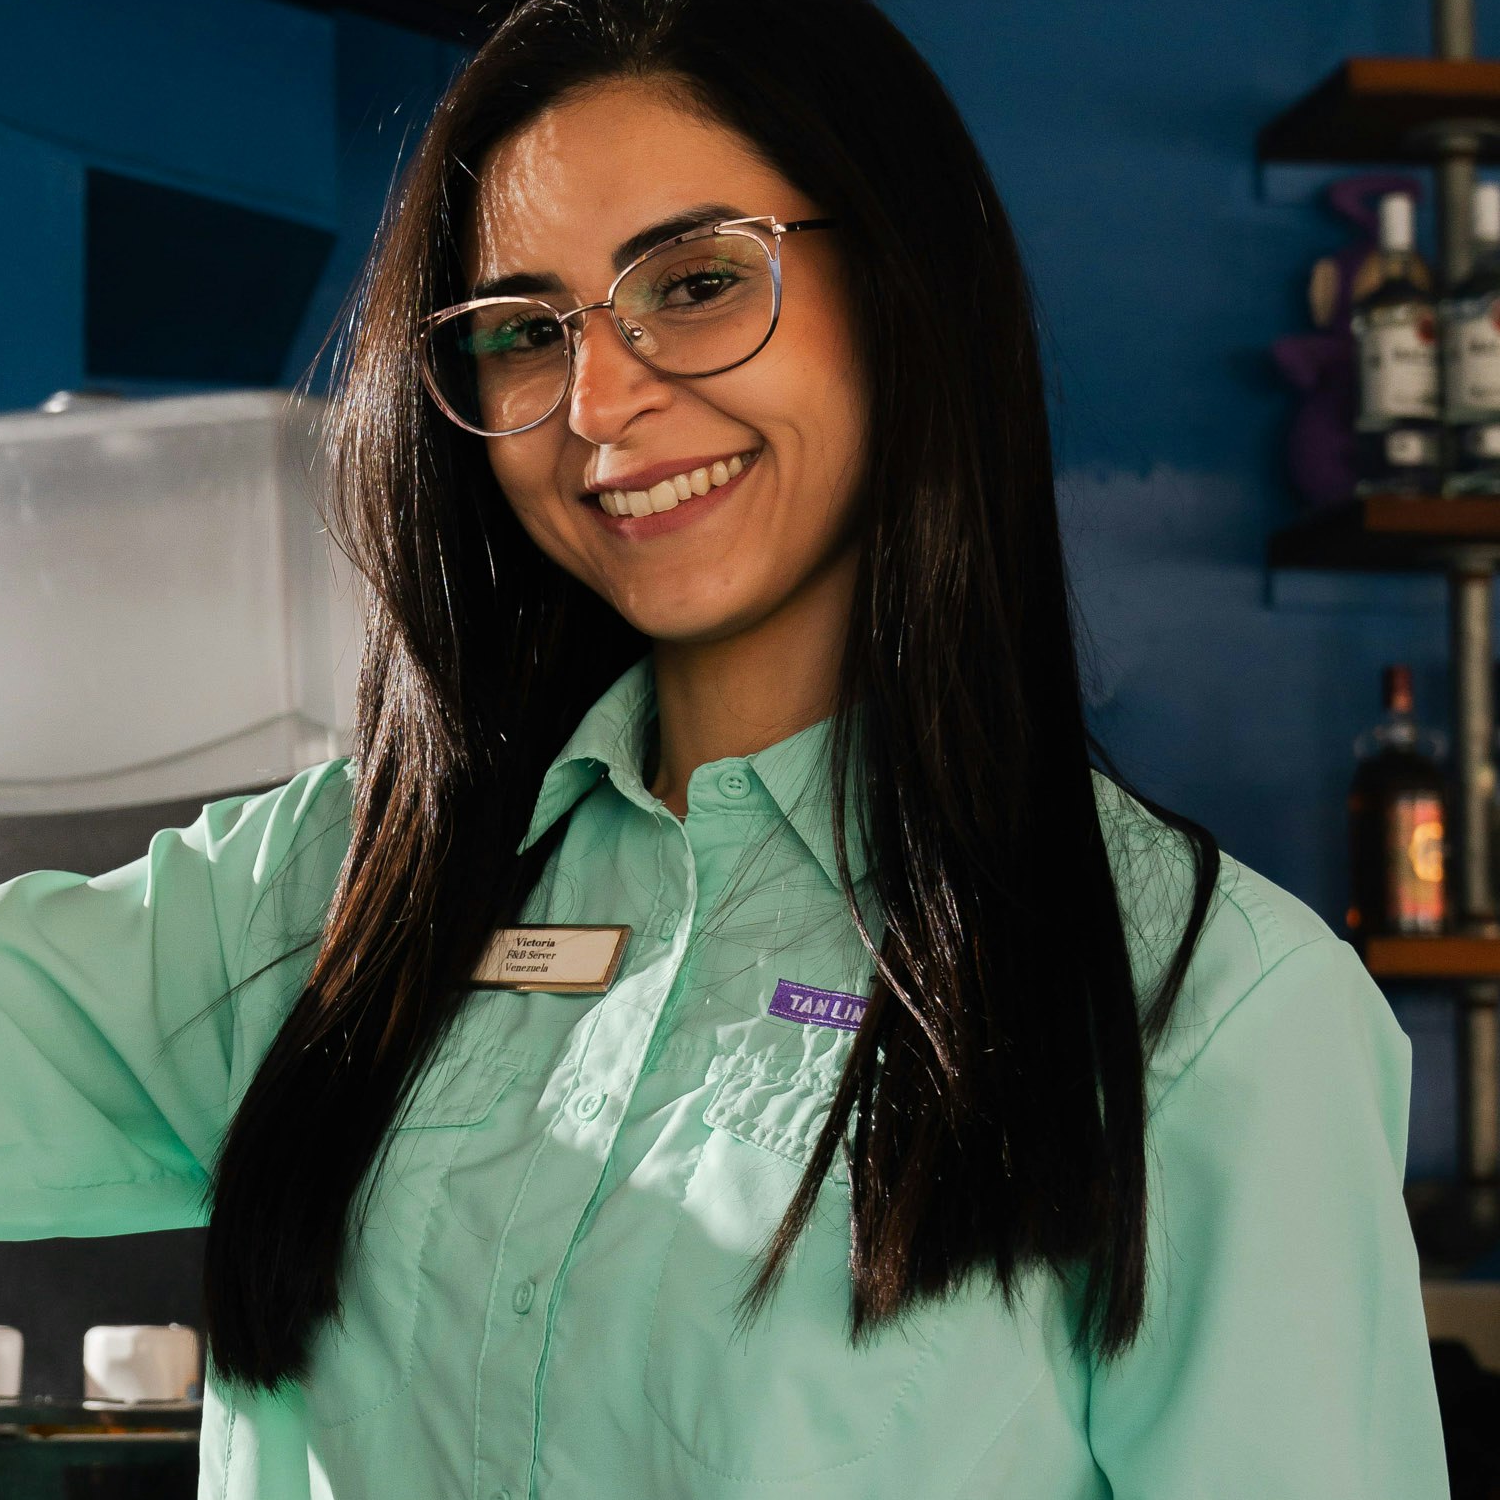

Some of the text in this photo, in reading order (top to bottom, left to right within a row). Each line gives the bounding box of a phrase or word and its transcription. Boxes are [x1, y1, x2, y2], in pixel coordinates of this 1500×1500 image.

[516, 937, 556, 948] Victoria
[506, 949, 557, 960] F&B Server
[505, 962, 549, 973] Venezuela
[789, 994, 830, 1017] TAN
